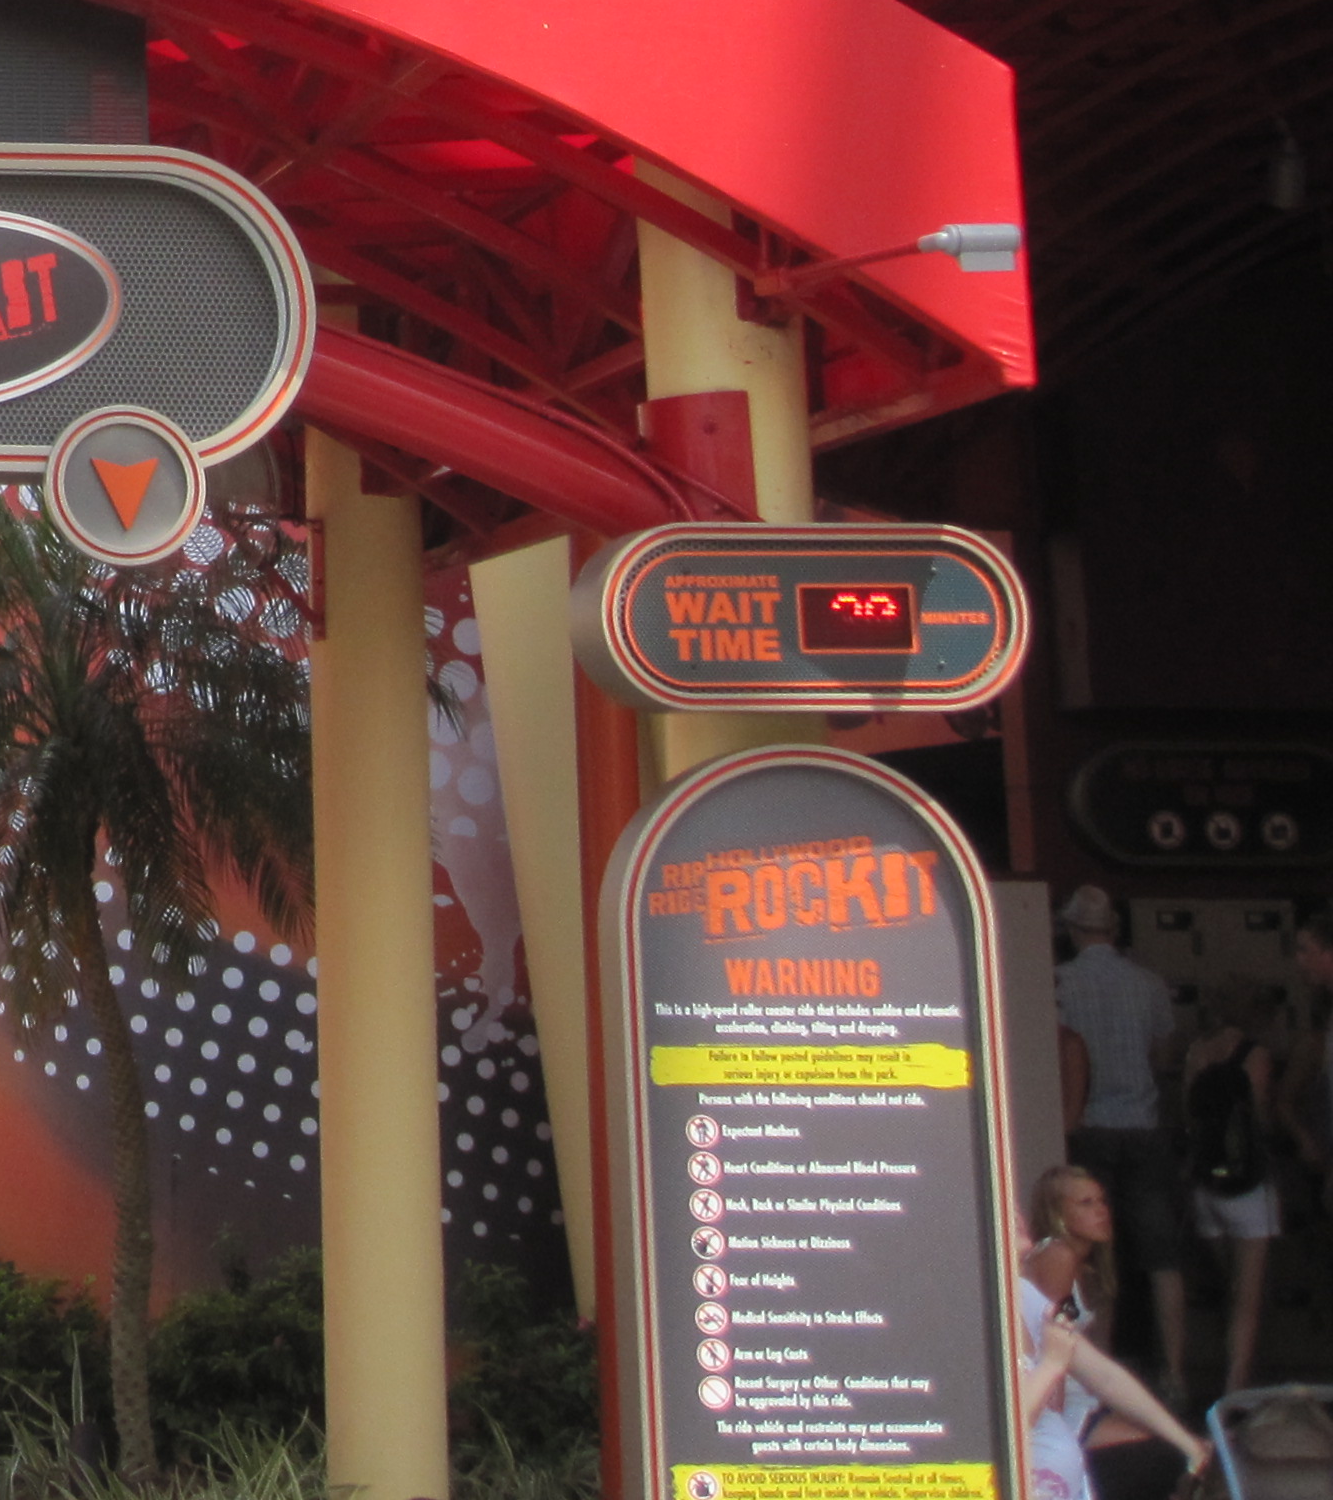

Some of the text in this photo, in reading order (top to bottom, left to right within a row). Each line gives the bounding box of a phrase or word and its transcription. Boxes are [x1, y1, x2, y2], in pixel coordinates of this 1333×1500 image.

[664, 575, 779, 588] APPROXIMATE
[664, 593, 781, 624] WAIT
[922, 612, 990, 625] MINUTES
[669, 630, 782, 661] TIME
[706, 836, 873, 868] HOLLYWOOD
[662, 861, 705, 888] RIP
[706, 851, 937, 934] ROCKIT
[724, 959, 880, 997] WARNING
[698, 1092, 732, 1104] Persons
[733, 1092, 753, 1104] with
[755, 1091, 769, 1105] the
[858, 1092, 886, 1105] should
[888, 1094, 902, 1105] not
[904, 1092, 924, 1105] ride.
[764, 1124, 799, 1136] Mothers
[723, 1161, 748, 1173] Heart
[796, 1164, 805, 1173] or
[852, 1160, 877, 1173] Blood
[728, 1236, 758, 1248] Motion
[798, 1239, 808, 1249] or
